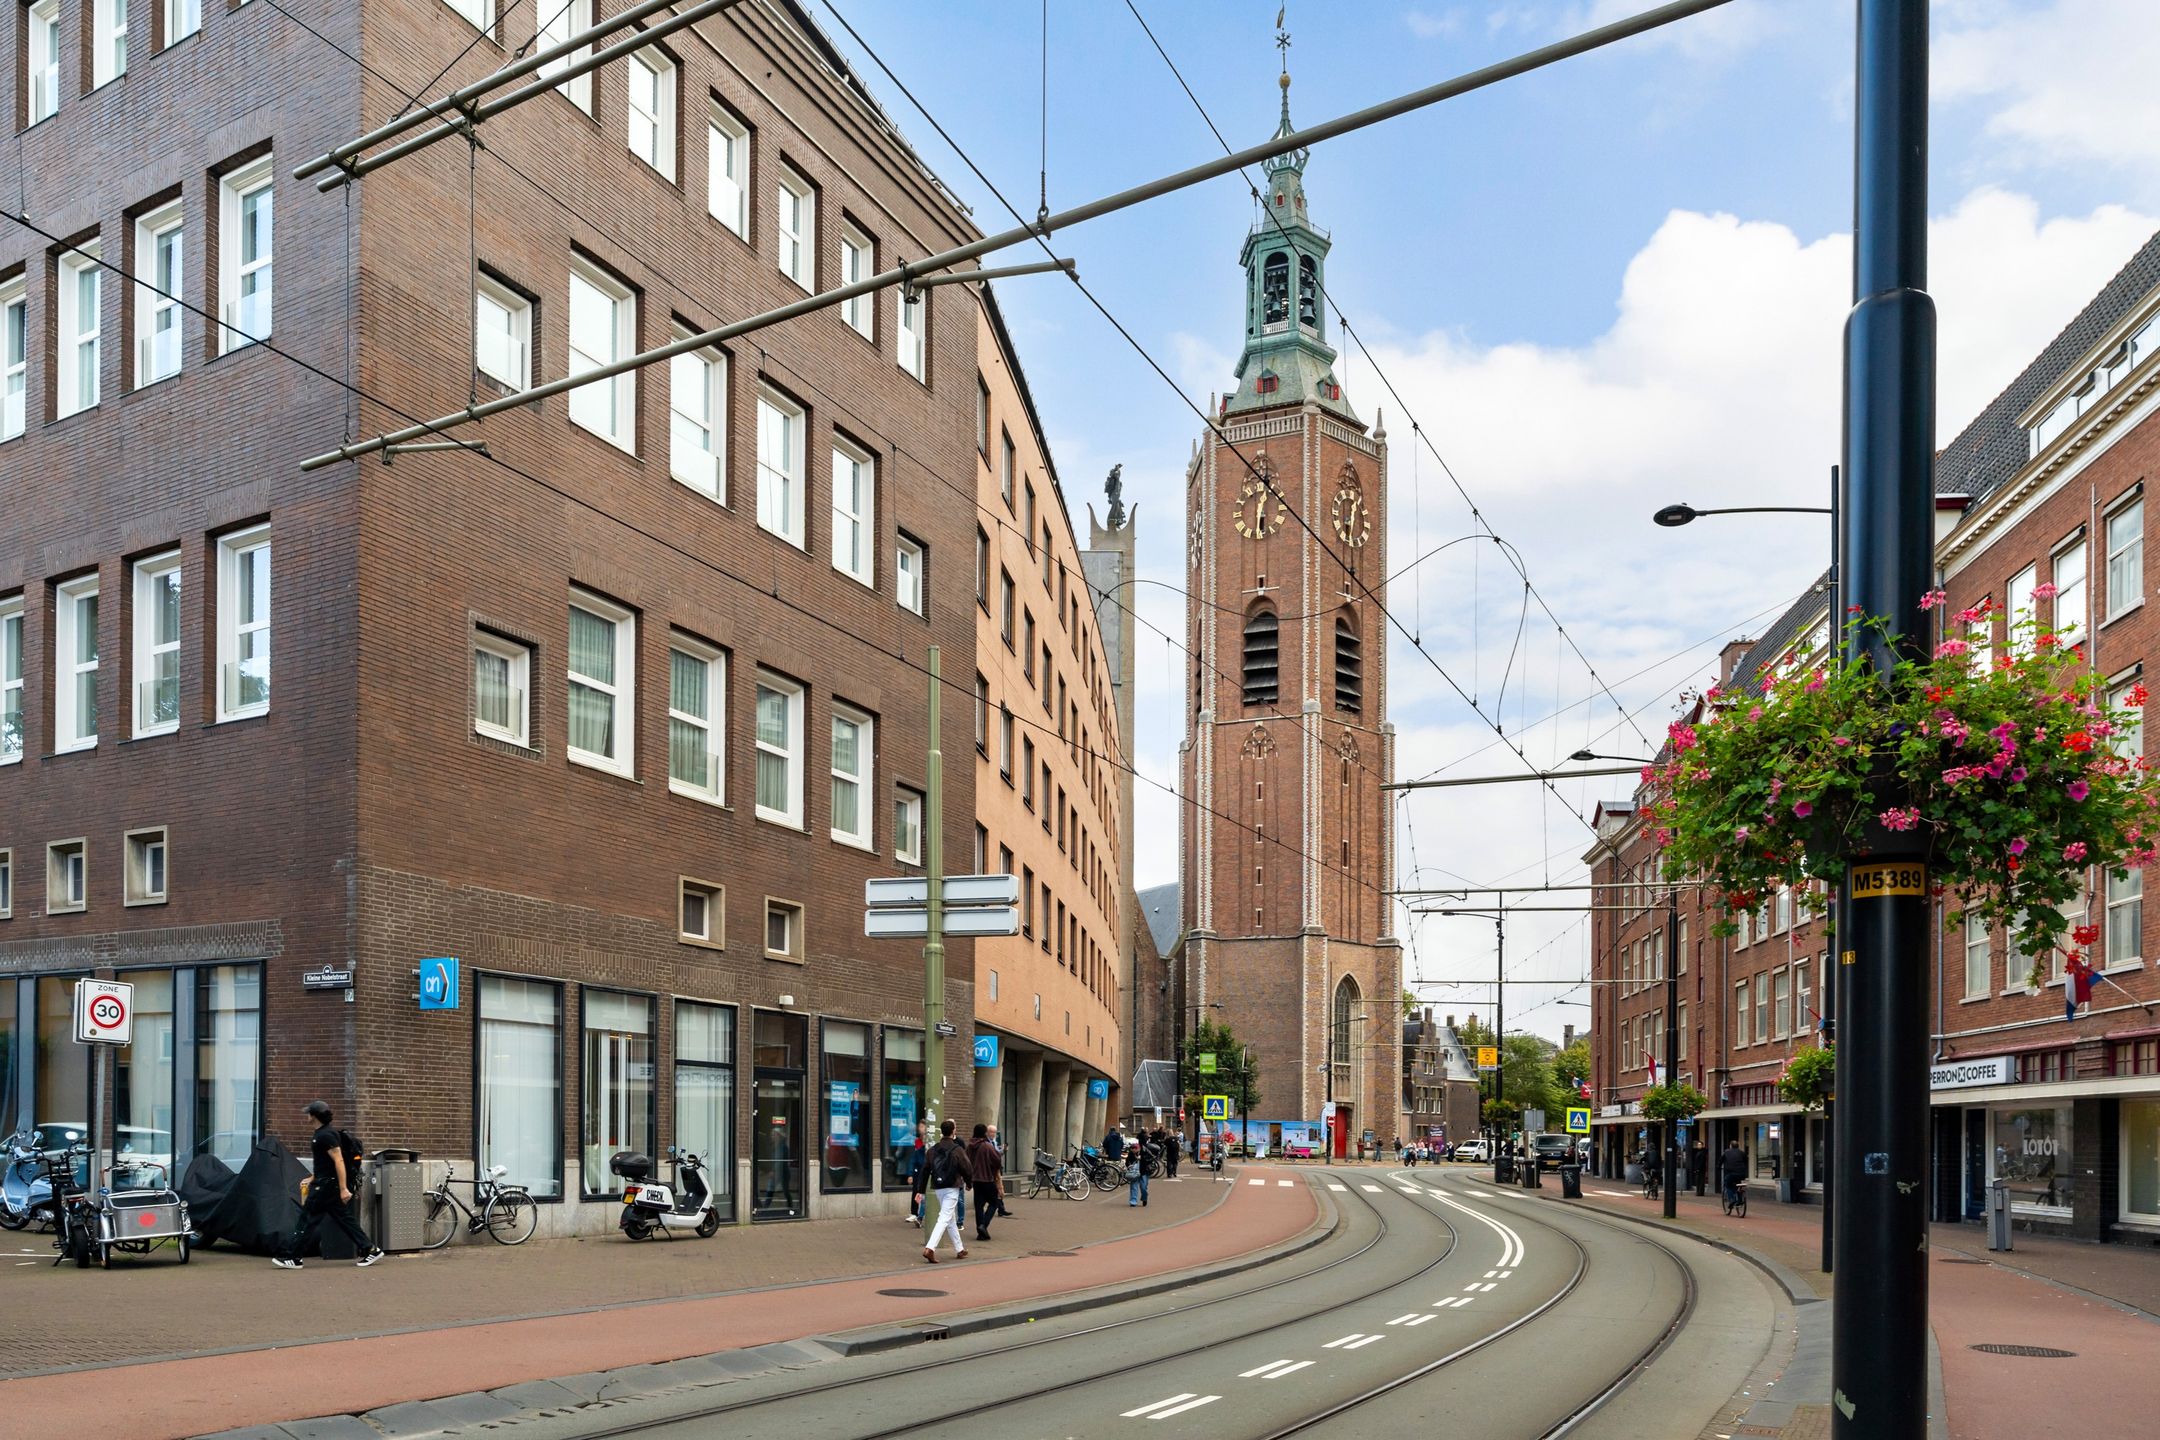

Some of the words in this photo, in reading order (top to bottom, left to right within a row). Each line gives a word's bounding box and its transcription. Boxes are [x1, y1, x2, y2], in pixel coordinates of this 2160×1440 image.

[1854, 870, 1921, 892] M5389
[1843, 952, 1855, 963] 13
[97, 985, 119, 993] ZONE
[96, 1004, 120, 1019] 30
[1966, 1064, 1997, 1081] COFFEE
